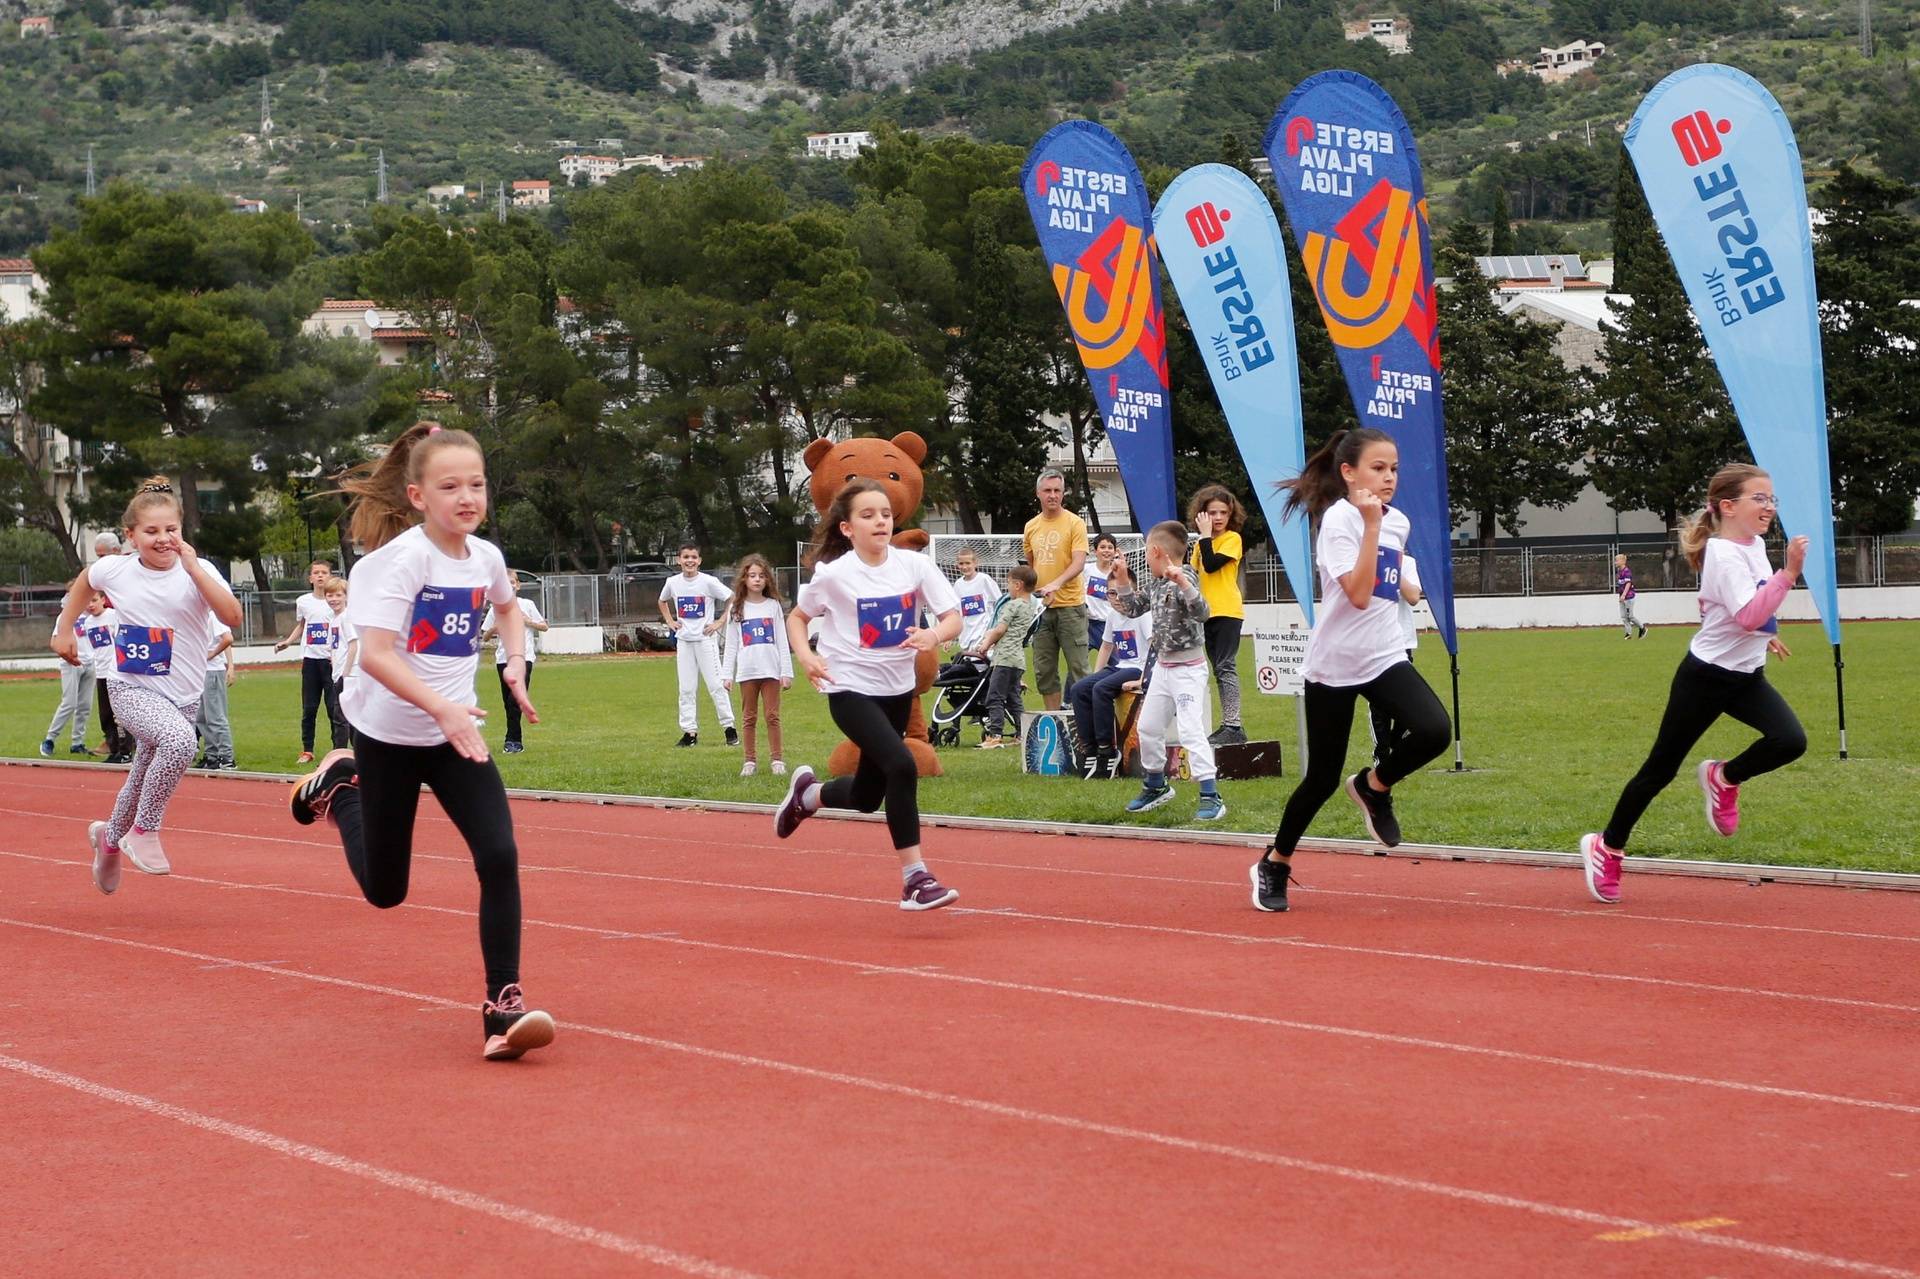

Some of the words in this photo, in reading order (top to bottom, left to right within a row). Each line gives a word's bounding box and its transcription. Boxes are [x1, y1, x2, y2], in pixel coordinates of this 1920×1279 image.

[1384, 566, 1399, 585] 16
[683, 603, 699, 612] 257
[442, 613, 471, 635] 85
[883, 613, 903, 631] 17
[311, 630, 328, 638] 506
[752, 627, 765, 636] 18
[1255, 632, 1280, 641] MOLIMO
[126, 643, 150, 660] 33
[1281, 645, 1305, 653] TRAVNJ
[1268, 655, 1291, 663] PLEASE
[1038, 714, 1060, 776] 2
